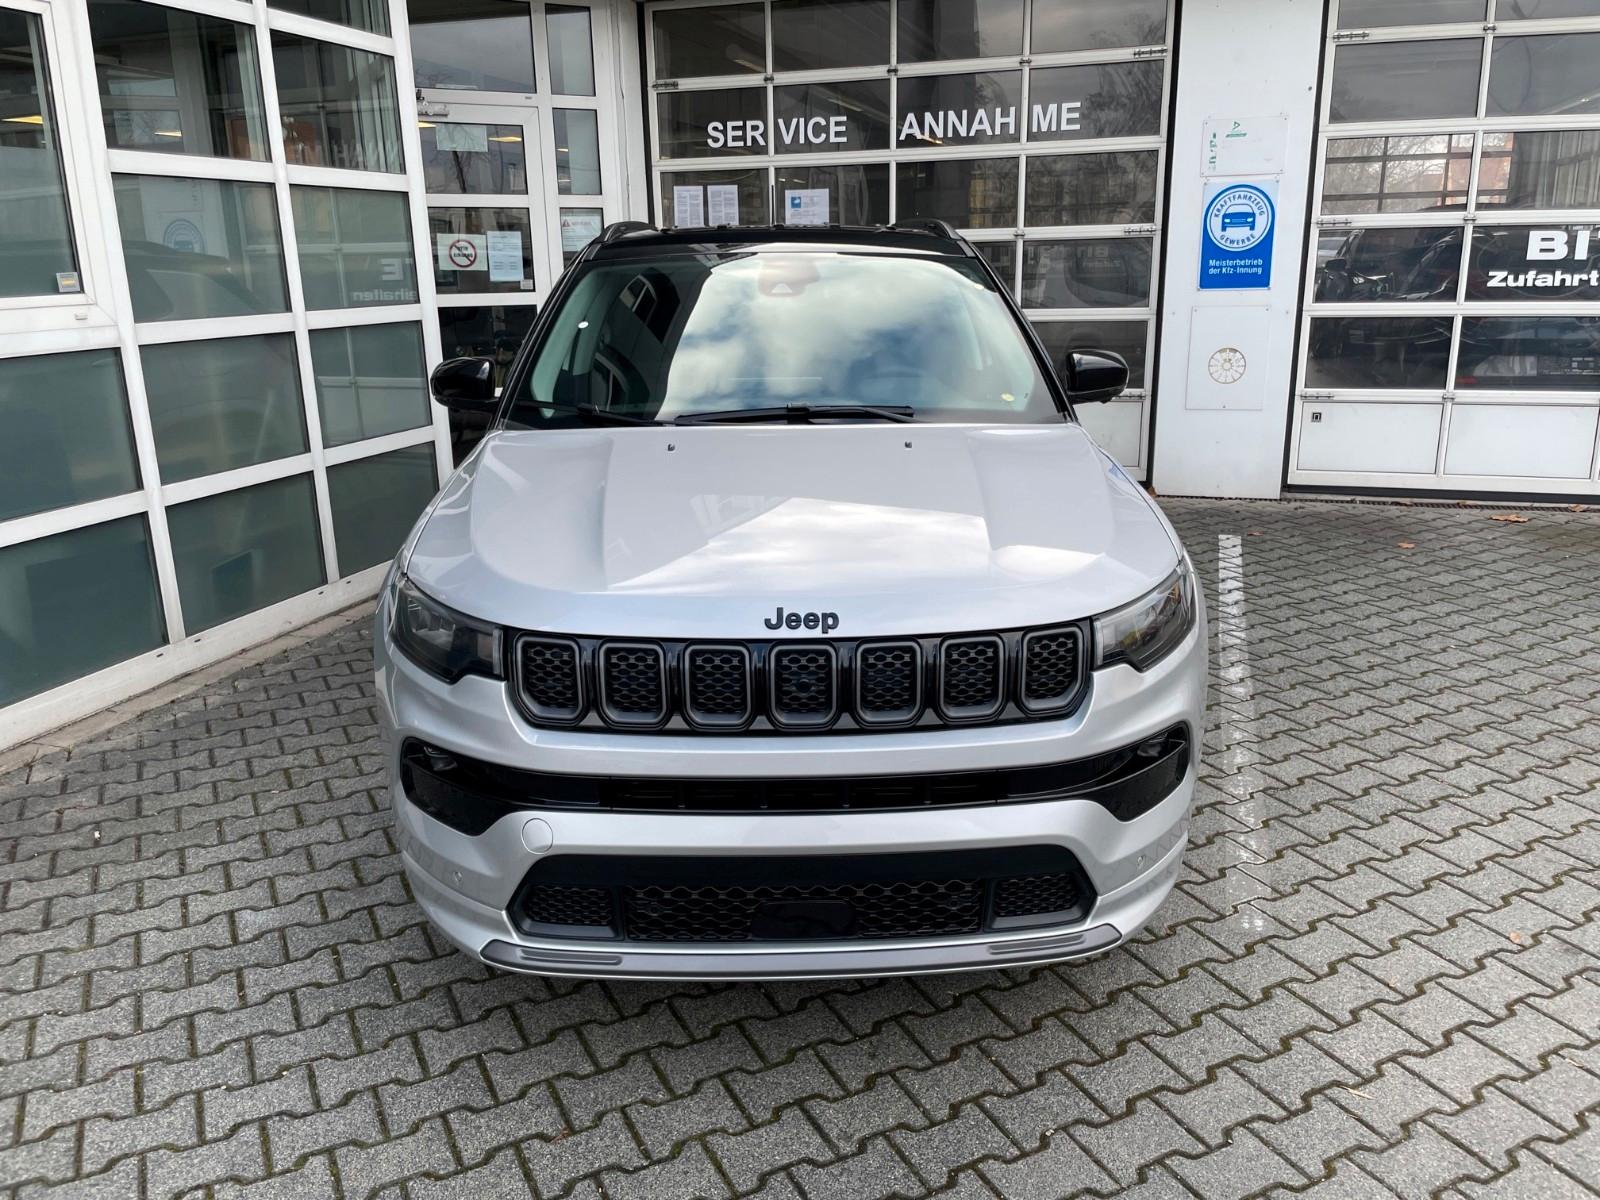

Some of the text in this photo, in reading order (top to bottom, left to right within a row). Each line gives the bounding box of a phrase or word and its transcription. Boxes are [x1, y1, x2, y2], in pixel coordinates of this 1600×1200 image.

[707, 101, 1081, 148] SERVICE ANNAHME
[1213, 192, 1266, 218] KRAFTFAHRZEUG
[1219, 232, 1257, 246] GEWERBE
[1526, 230, 1600, 260] BI
[1208, 258, 1263, 268] Meisterbetrieb
[1208, 266, 1263, 276] der Kfz-Innung
[1486, 270, 1600, 287] Zufahrt
[764, 607, 840, 634] Jeep
